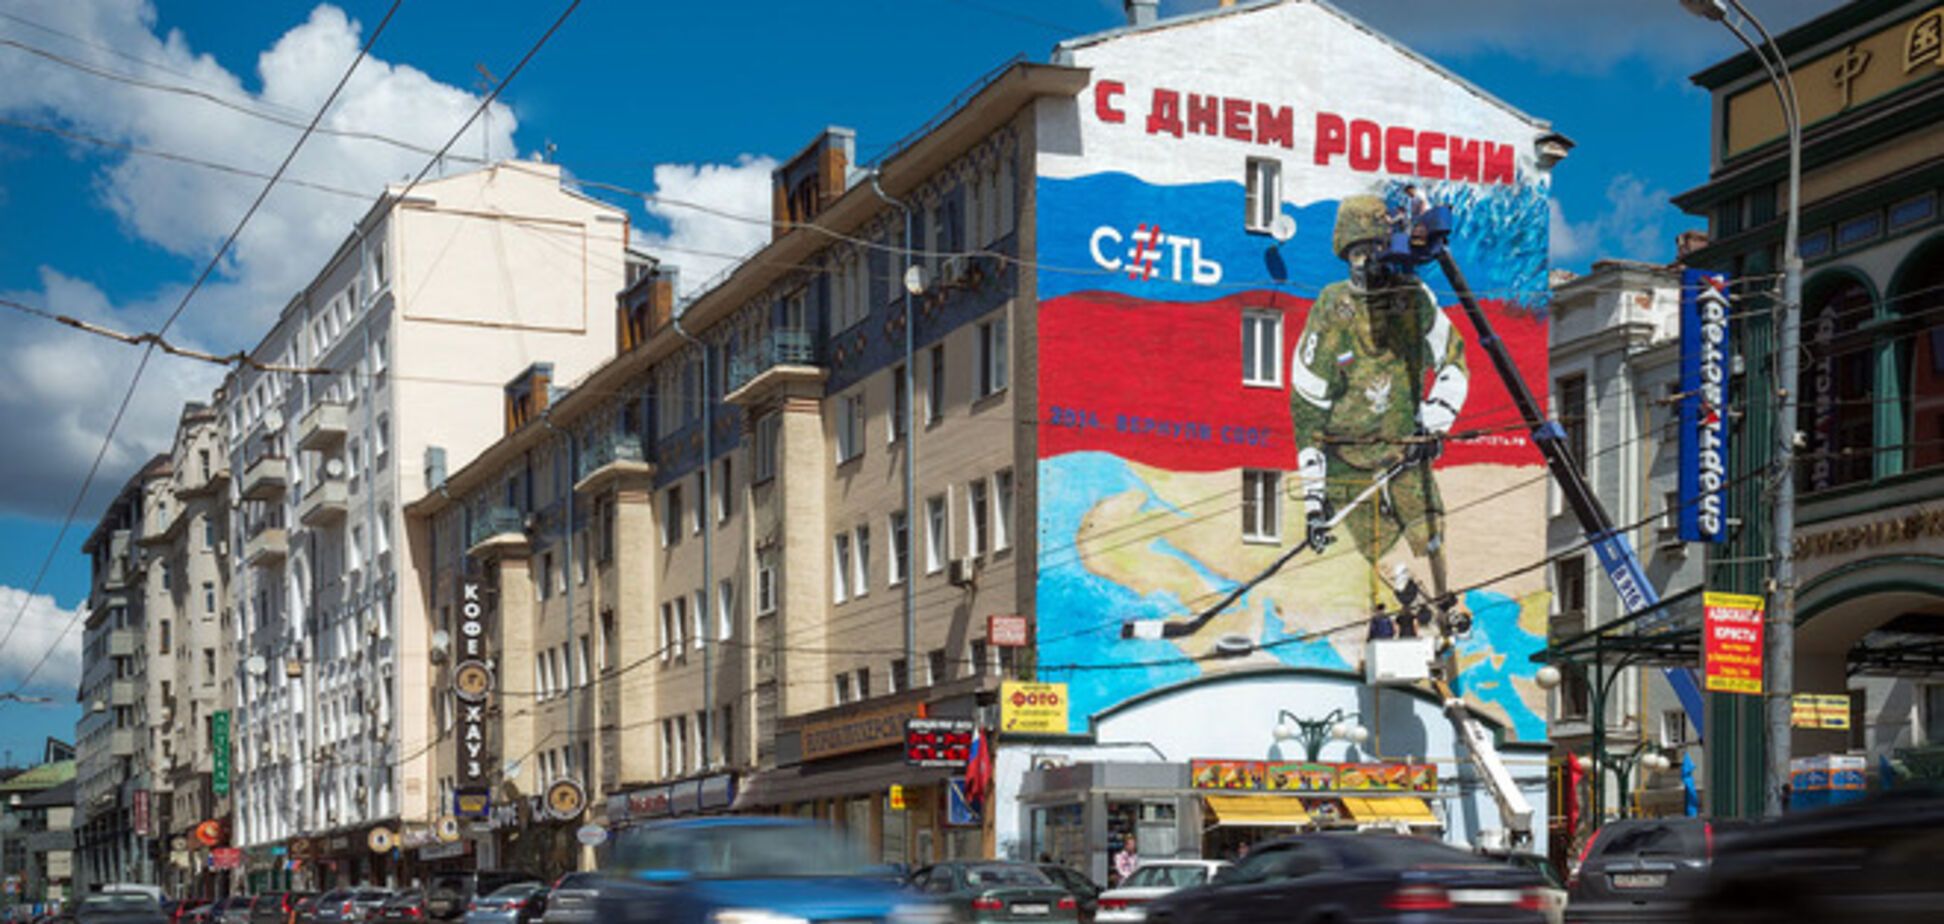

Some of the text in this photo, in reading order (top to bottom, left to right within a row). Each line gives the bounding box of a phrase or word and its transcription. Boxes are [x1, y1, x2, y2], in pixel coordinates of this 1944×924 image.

[1095, 79, 1515, 185] С ДНЕМ РОССИИ
[463, 584, 482, 655] КОФЕ
[465, 706, 482, 778] ХАУЗ
